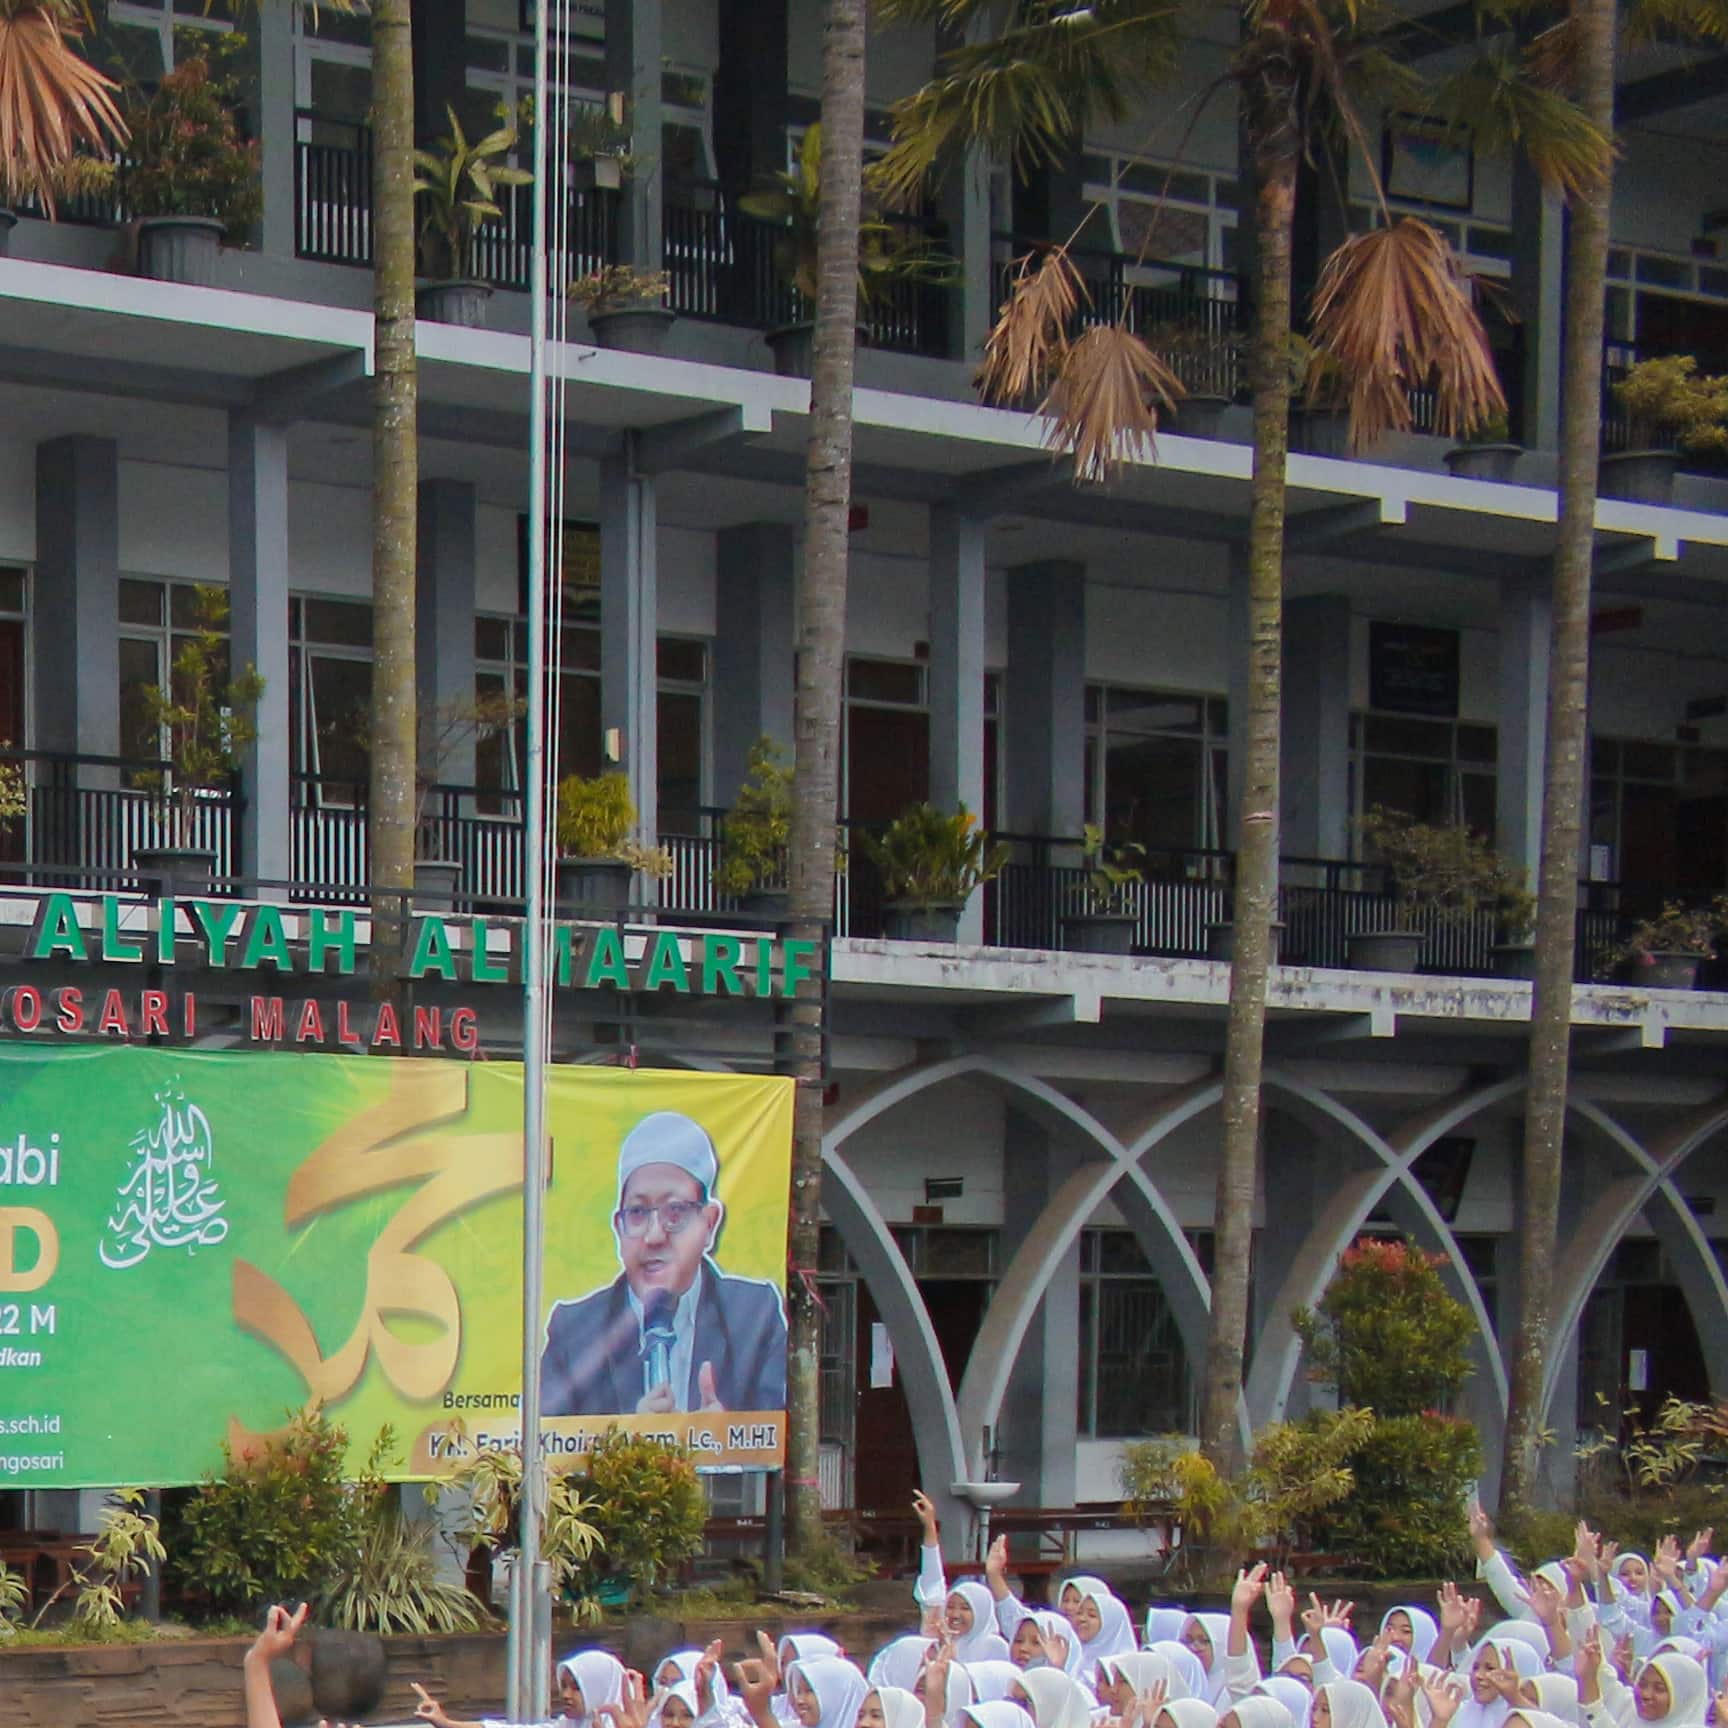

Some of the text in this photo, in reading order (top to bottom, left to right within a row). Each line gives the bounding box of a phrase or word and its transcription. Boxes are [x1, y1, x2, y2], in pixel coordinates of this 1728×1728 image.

[33, 892, 356, 975] ALIYAH
[251, 996, 479, 1050] MALANG
[30, 1304, 56, 1335] M
[444, 1391, 521, 1410] Bersama
[728, 1424, 777, 1449] M.HI
